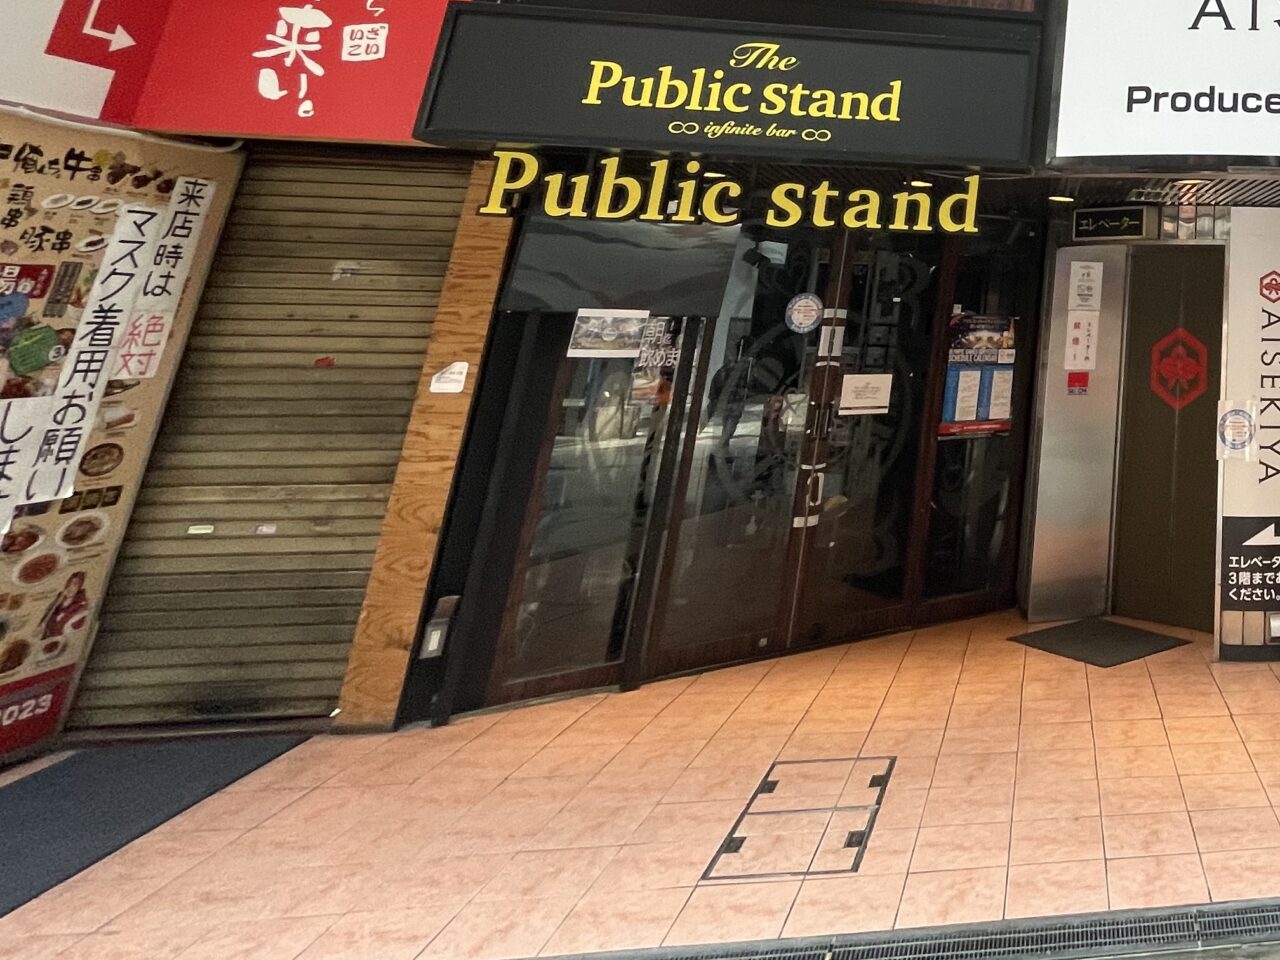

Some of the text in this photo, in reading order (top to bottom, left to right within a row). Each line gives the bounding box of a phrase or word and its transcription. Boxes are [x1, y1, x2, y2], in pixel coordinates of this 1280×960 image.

[729, 41, 801, 72] The
[580, 58, 902, 123] Public stand
[702, 120, 797, 141] infinite bar
[478, 150, 981, 235] Public stand
[1078, 216, 1140, 231] エレベーター
[114, 178, 209, 378] 来店時は 絶対
[26, 207, 158, 501] マスク着用お願い
[0, 693, 54, 727] 023
